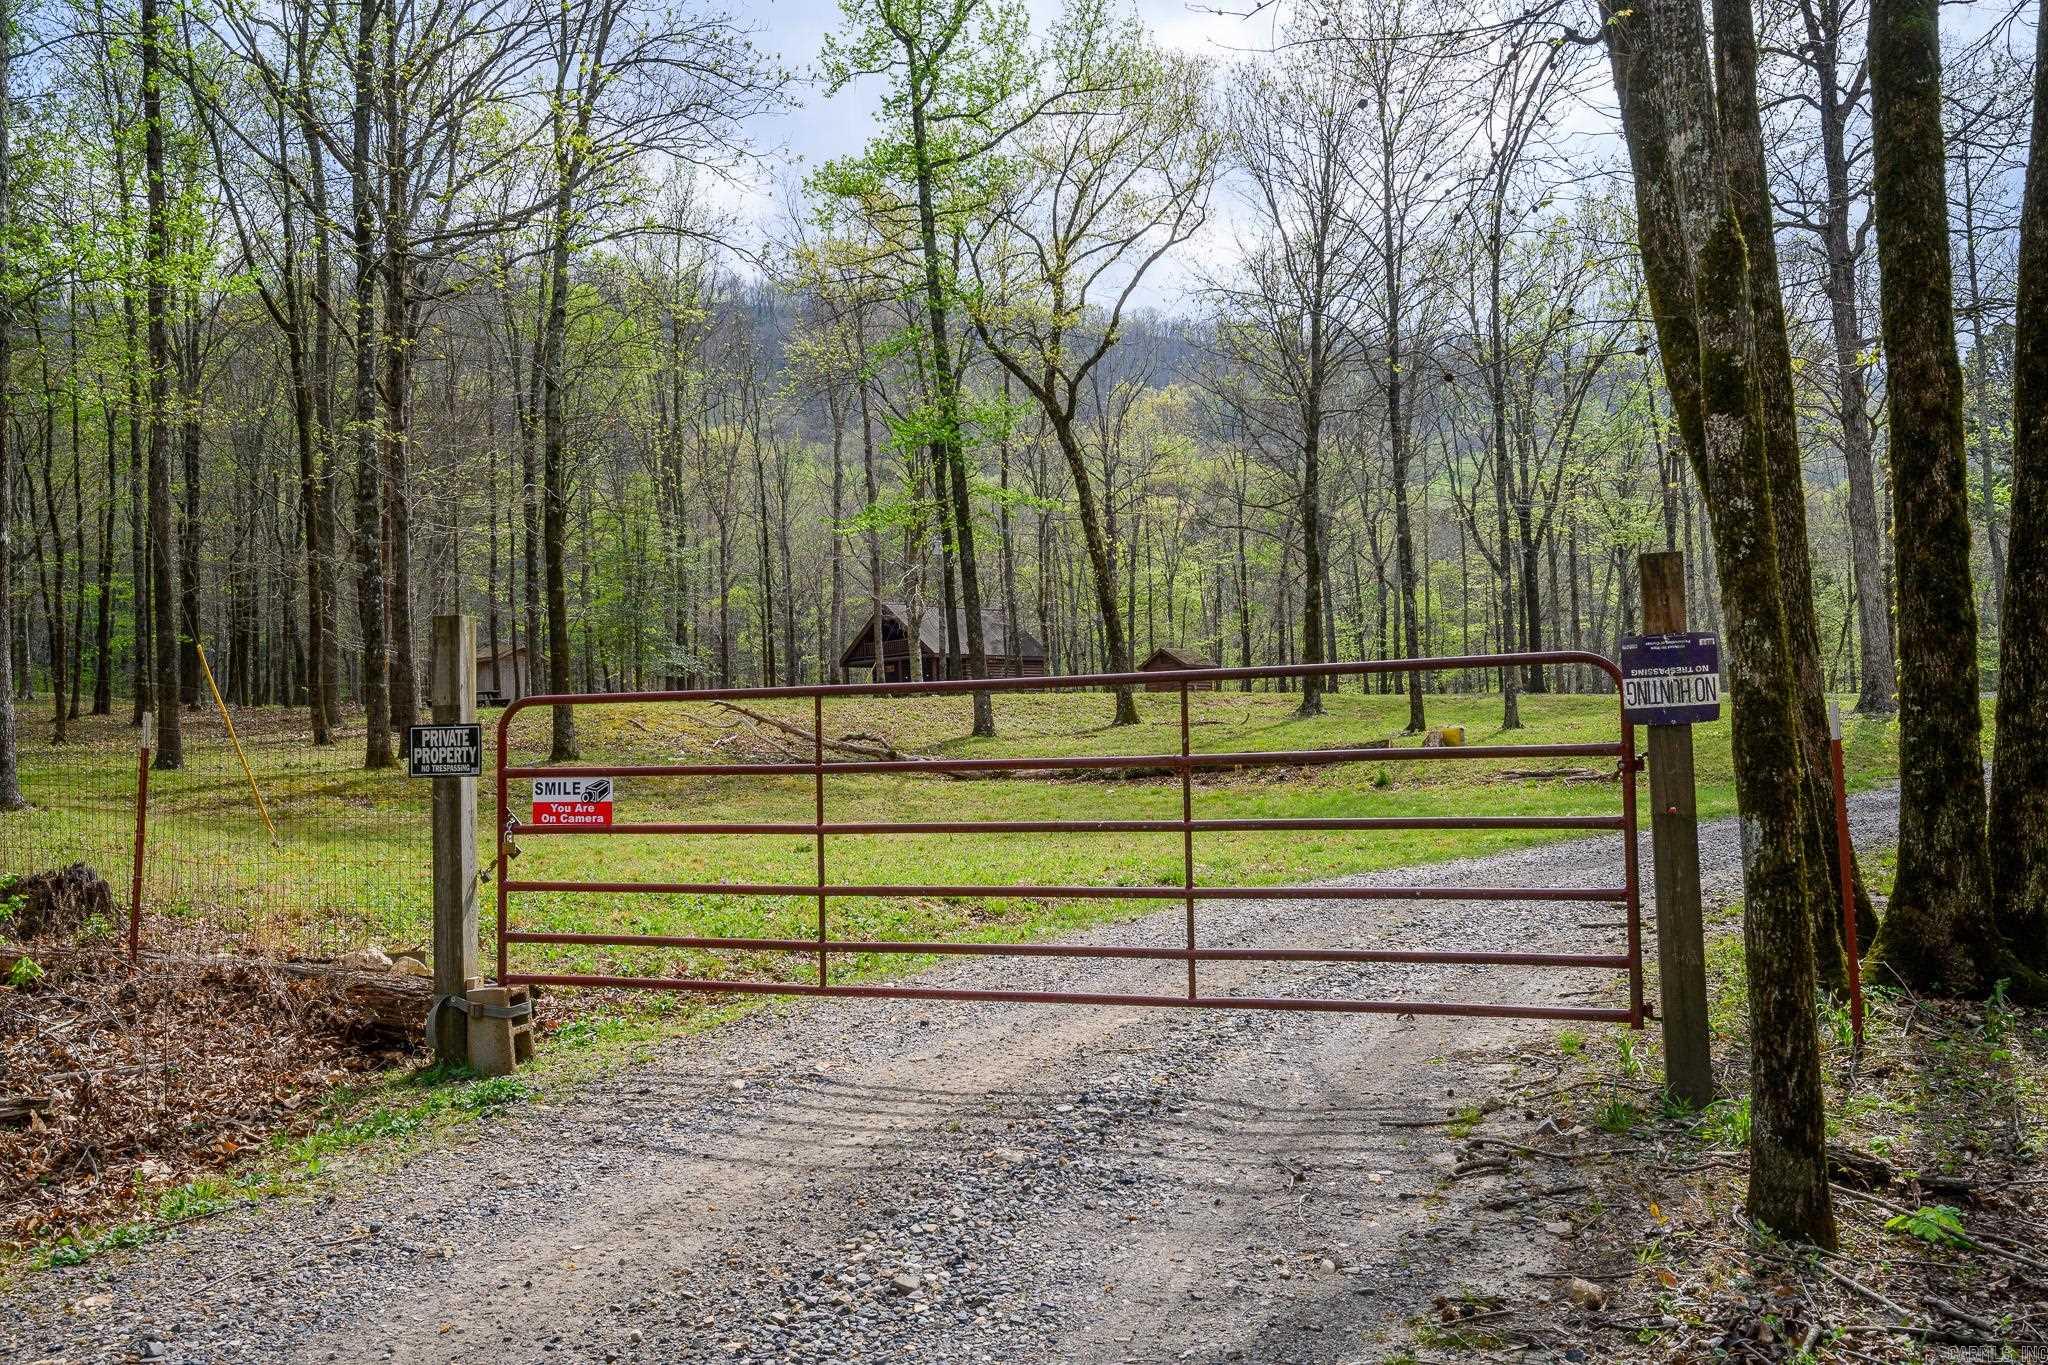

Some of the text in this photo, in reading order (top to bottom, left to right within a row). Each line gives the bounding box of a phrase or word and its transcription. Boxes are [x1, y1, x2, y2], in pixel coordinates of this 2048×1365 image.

[1631, 666, 1693, 676] TRESPASSING
[1626, 677, 1717, 706] NO HUNTING
[421, 729, 470, 747] PRIVATE
[413, 746, 477, 764] PROPERTY
[421, 764, 430, 772] NO
[431, 764, 470, 772] TRESPASSING
[534, 782, 581, 796] SMILE
[550, 803, 595, 813] You Are
[541, 813, 604, 823] On Camera
